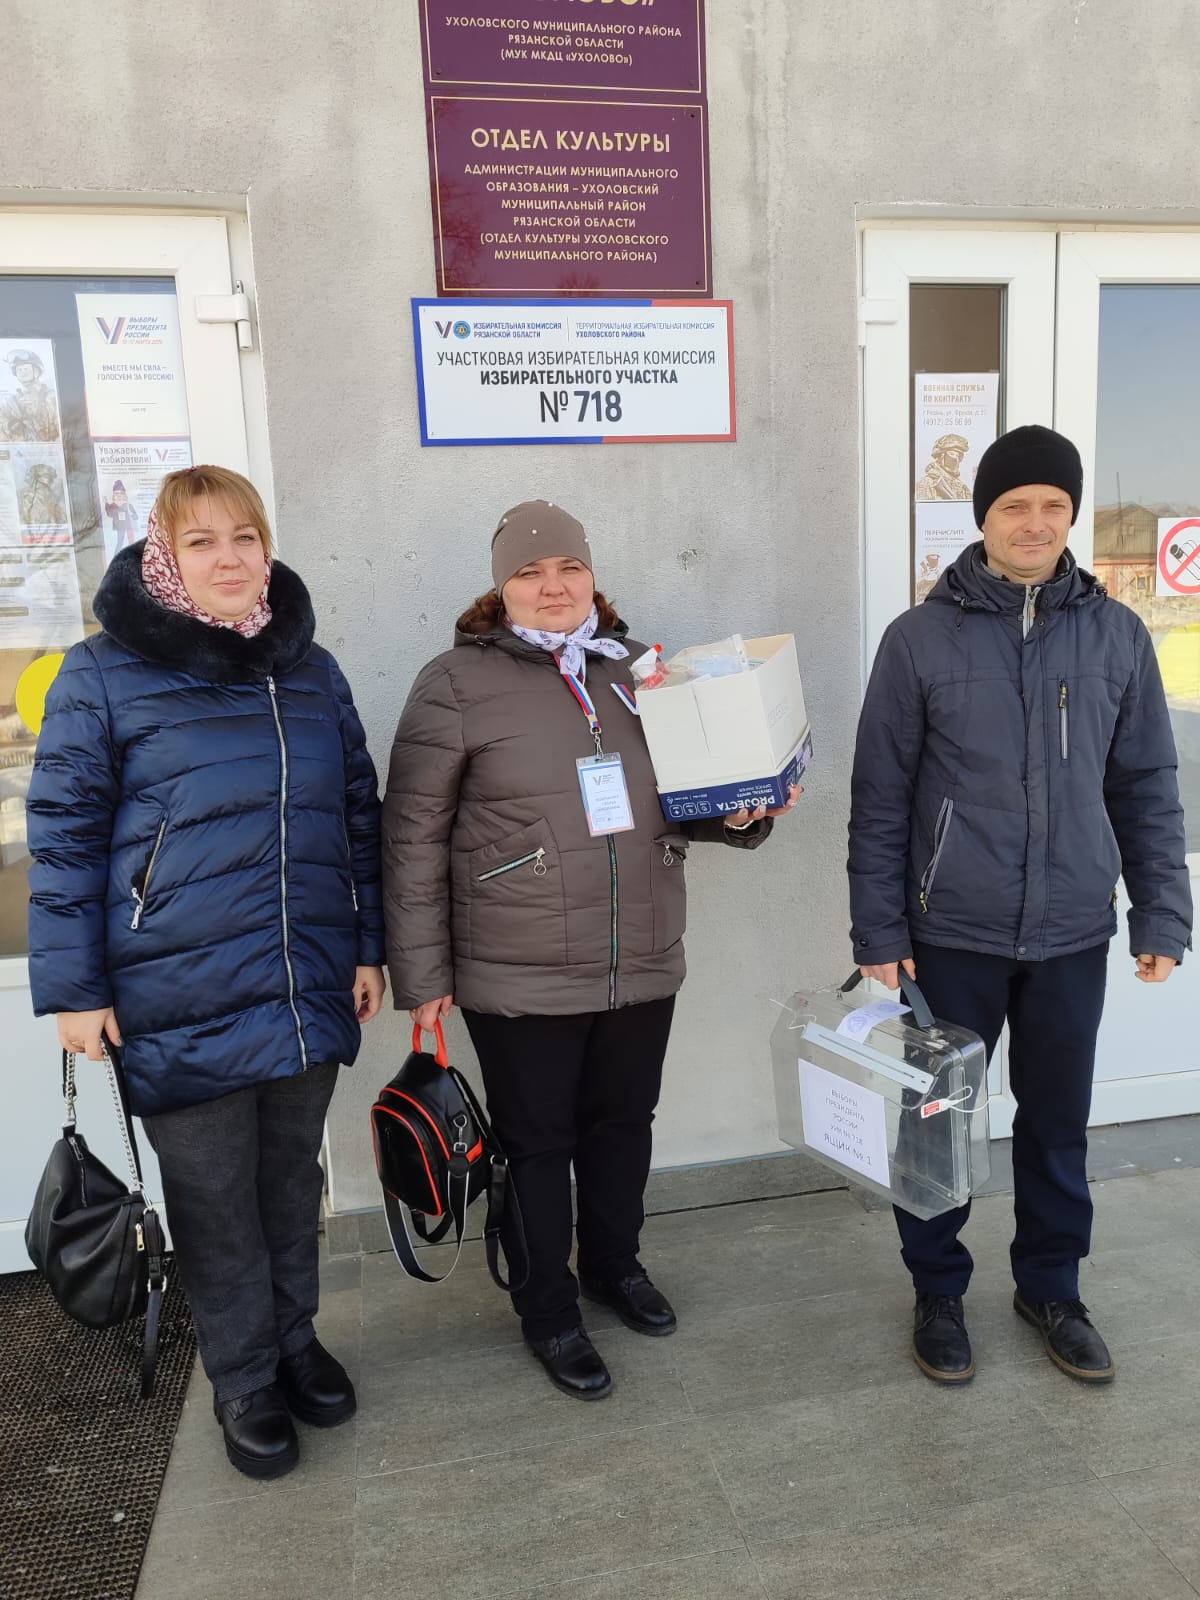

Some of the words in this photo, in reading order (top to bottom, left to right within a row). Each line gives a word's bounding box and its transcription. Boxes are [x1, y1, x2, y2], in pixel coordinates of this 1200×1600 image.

[445, 16, 530, 30] УХОЛОВСКОГО
[533, 21, 636, 35] МУНИЦИПАЛЬНОГО
[638, 25, 682, 37] РАЙОНА
[508, 34, 572, 47] РЯЗАНСКОЙ
[575, 37, 624, 49] ОБЛАСТИ
[500, 48, 528, 61] (МУК
[531, 50, 563, 62] МКДЦ
[566, 51, 633, 66] «УХОЛОВО»)
[471, 127, 548, 150] ОТДЕЛ
[556, 130, 670, 153] КУЛЬТУРЫ
[464, 164, 567, 178] АДМИНИСТРАЦИИ
[570, 166, 679, 179] МУНИЦИПАЛЬНОГО
[486, 181, 570, 194] ОБРАЗОВАНИЯ
[581, 182, 660, 196] УХОЛОВСКИЙ
[501, 198, 605, 212] МУНИЦИПАЛЬНЫЙ
[608, 199, 646, 212] РАЙОН
[513, 214, 581, 228] РЯЗАНСКОЙ
[584, 217, 636, 229] ОБЛАСТИ
[480, 233, 522, 246] (ОТДЕЛ
[525, 233, 581, 245] КУЛЬТУРЫ
[584, 234, 669, 246] УХОЛОВСКОГО
[494, 249, 604, 262] МУНИЦИПАЛЬНОГО
[607, 249, 658, 264] РАЙОНА)
[473, 322, 526, 331] ИЗБИРАТЕЛЬНАЯ
[527, 322, 562, 330] КОМИССИЯ
[576, 322, 632, 330] ТЕРРИТОРИАЛЬНАЯ
[633, 322, 681, 330] ИЗБИРАТЕЛЬНАЯ
[682, 322, 715, 330] КОМИССИЯ
[473, 330, 511, 339] РЯЗАНСКОЙ
[512, 331, 541, 339] ОБЛАСТИ
[576, 330, 620, 339] УХОЛОВСКОГО
[621, 329, 646, 338] РАЙОНА
[437, 351, 524, 367] УЧАСТКОВАЯ
[528, 350, 639, 366] ИЗБИРАТЕЛЬНАЯ
[643, 349, 715, 365] КОМИССИЯ
[480, 370, 612, 386] ИЗБИРАТЕЛЬНОГО
[616, 369, 678, 385] УЧАСТКА
[574, 390, 622, 422] 718
[716, 794, 776, 812] PROJECTA
